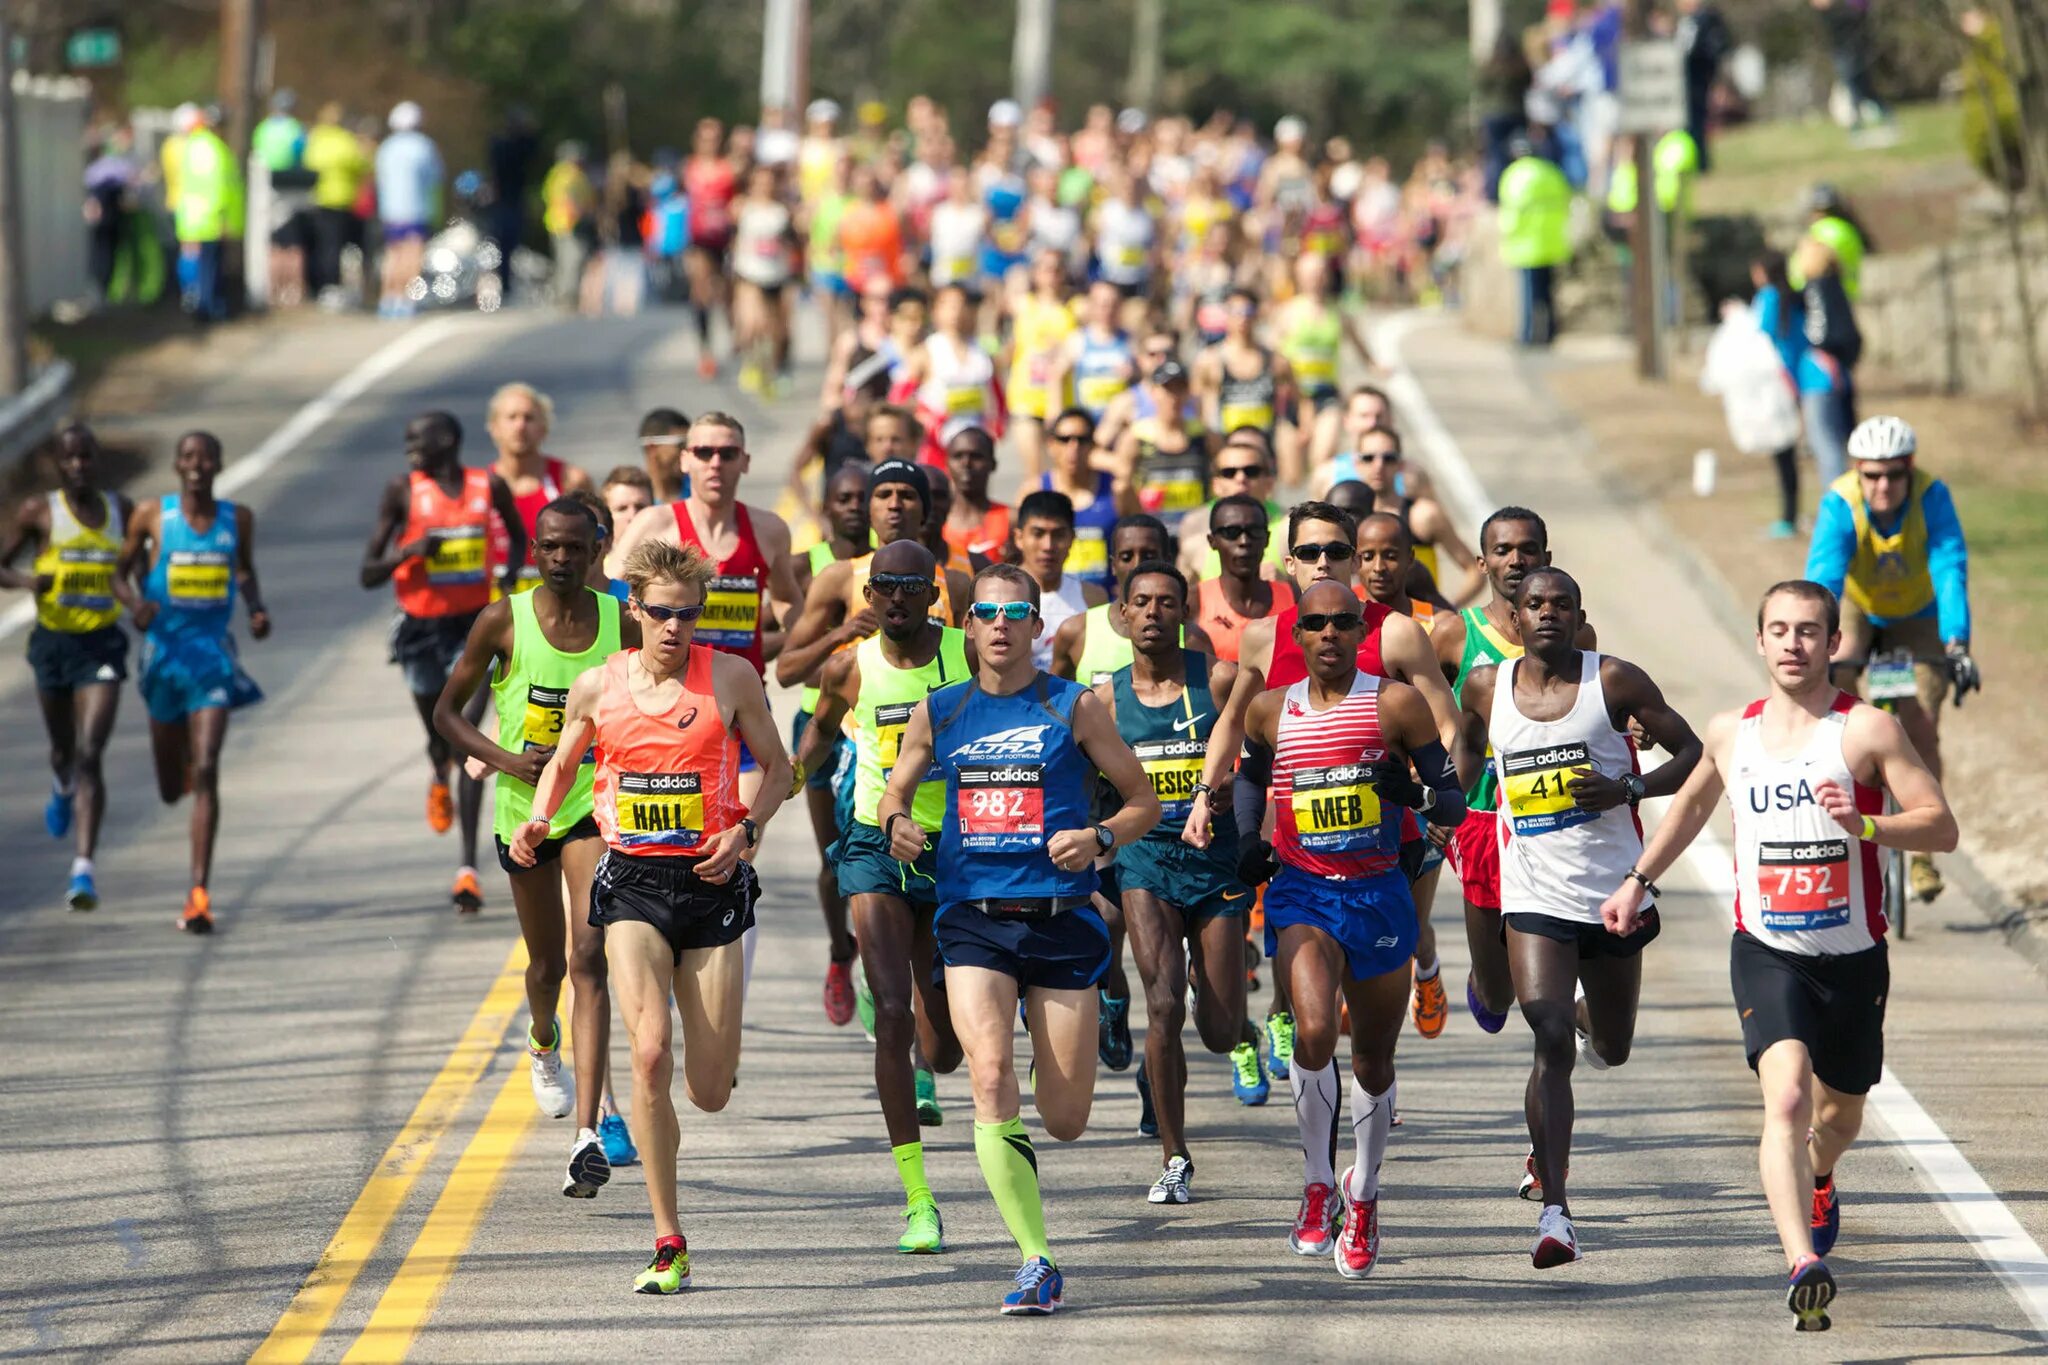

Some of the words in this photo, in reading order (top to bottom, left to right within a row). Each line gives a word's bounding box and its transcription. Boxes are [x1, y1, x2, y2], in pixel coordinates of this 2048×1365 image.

[947, 741, 1044, 758] ALTRA
[1536, 748, 1586, 765] adidas
[650, 776, 697, 789] adidas
[990, 768, 1040, 782] adidas
[1326, 766, 1373, 782] adidas
[1530, 771, 1565, 799] 41
[972, 790, 1025, 817] 982
[1750, 778, 1816, 814] USA
[633, 802, 687, 832] HALL
[1311, 794, 1363, 829] MEB
[1793, 844, 1845, 860] adidas
[1774, 866, 1834, 896] 752
